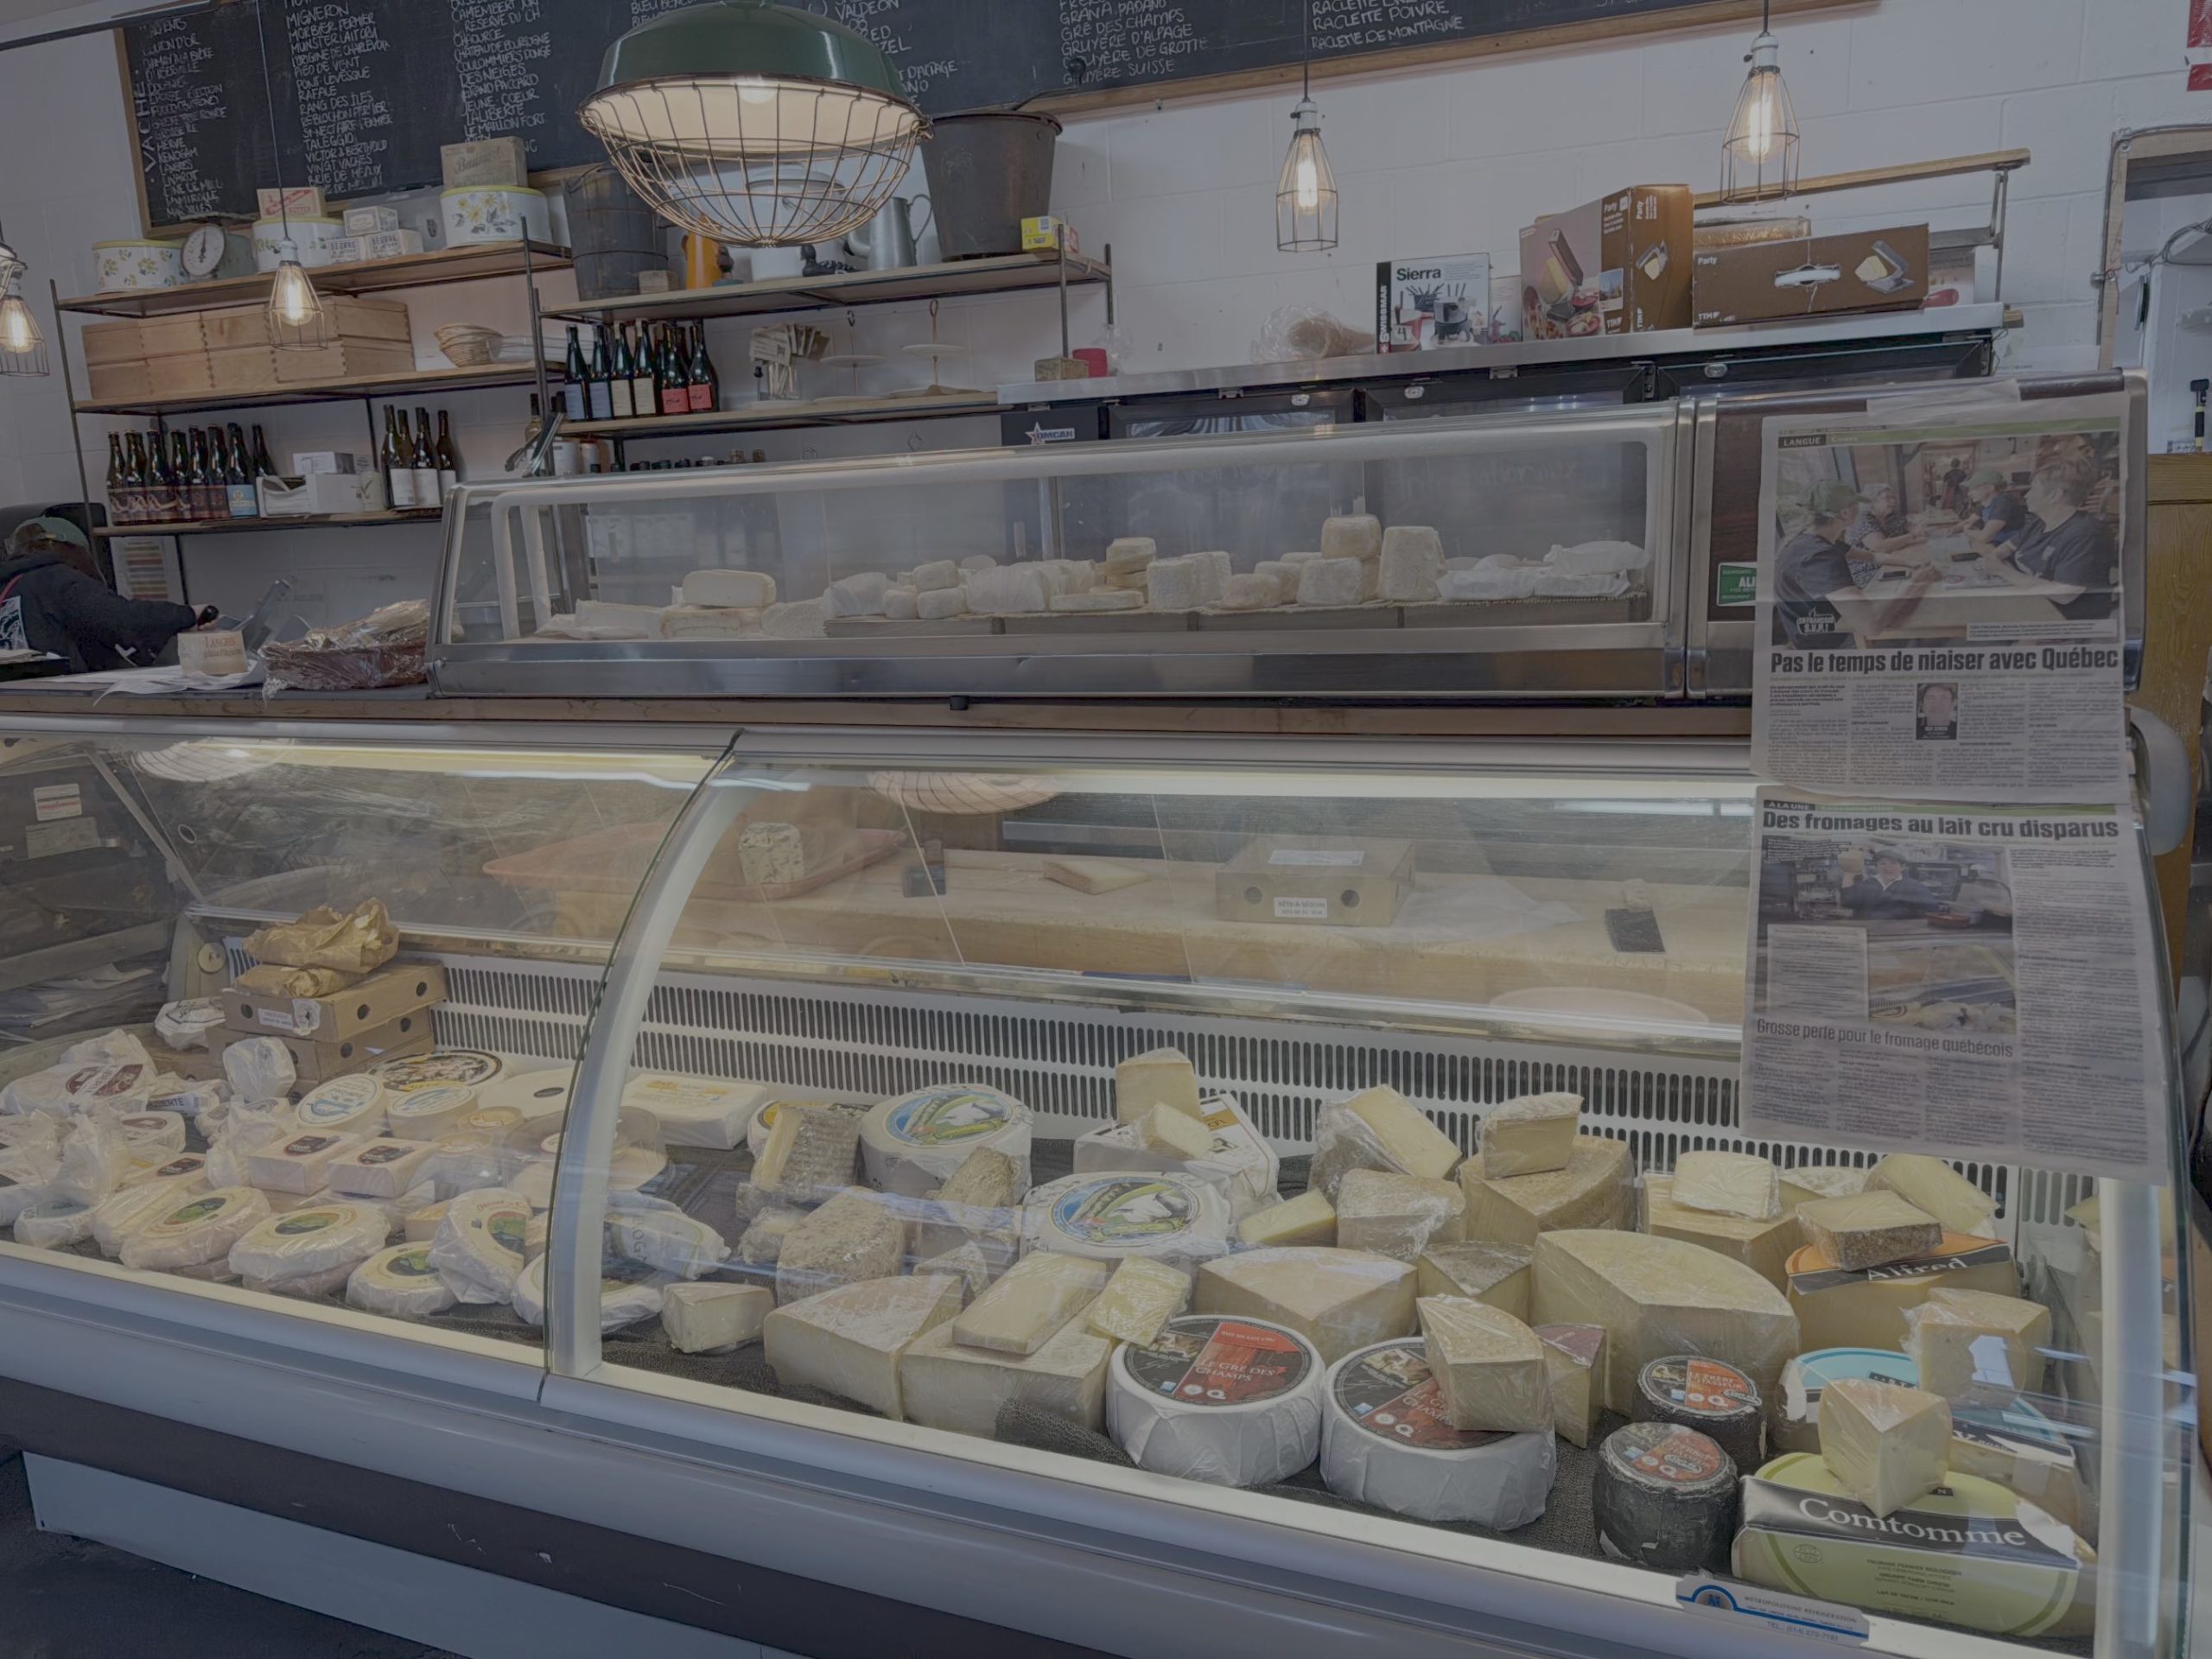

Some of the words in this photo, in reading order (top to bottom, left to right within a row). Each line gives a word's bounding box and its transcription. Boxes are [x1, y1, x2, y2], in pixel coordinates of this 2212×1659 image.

[286, 3, 349, 29] MIGNERON
[1059, 3, 1114, 25] GRANA
[1096, 19, 1123, 35] DES
[1125, 8, 1185, 29] CHAMPS
[1313, 10, 1382, 31] RACLETTE
[1389, 0, 1450, 22] POIVRE
[289, 22, 337, 42] MORBIER
[1131, 22, 1193, 45] D'ALPAGE
[1365, 29, 1387, 44] DE
[1388, 16, 1465, 39] MONTAGNE
[290, 35, 340, 54] MUNSTER
[332, 55, 359, 71] VENT
[1063, 49, 1131, 70] GUYÈRE
[1136, 46, 1156, 59] DE
[1128, 59, 1175, 77] SUISSE
[482, 62, 526, 80] NEIGES
[297, 86, 337, 103] RAFALE
[330, 95, 348, 110] DES
[464, 124, 476, 138] LE
[521, 112, 546, 127] FORT
[303, 132, 354, 151] TALEGGIO
[305, 148, 338, 163] VICTOR
[1698, 256, 1718, 265] Party
[1396, 268, 1441, 282] Sierra
[1783, 437, 1821, 447] LANGUE
[1771, 652, 1803, 673] Pas
[1808, 652, 1824, 673] le
[1828, 653, 1886, 674] temps
[1891, 651, 1913, 671] de
[1918, 650, 1985, 671] niaiser
[1990, 652, 2037, 671] avec
[2042, 647, 2119, 671] Québec
[1764, 811, 1800, 830] Des
[1805, 813, 1903, 832] fromages
[1908, 819, 1933, 835] au
[1938, 817, 1973, 835] lait
[1978, 822, 2014, 837] cru
[2019, 820, 2120, 841] disparus
[1757, 1019, 1800, 1037] Grosse
[1803, 1025, 1835, 1040] perte
[1839, 1032, 1867, 1045] pour
[1870, 1030, 1882, 1045] le
[1885, 1031, 1940, 1052] fromage
[1942, 1037, 2014, 1058] québécois
[1867, 1257, 1969, 1281] Alfred
[1196, 1367, 1253, 1382] CHAMPS
[1799, 1498, 2027, 1547] Comtomme
